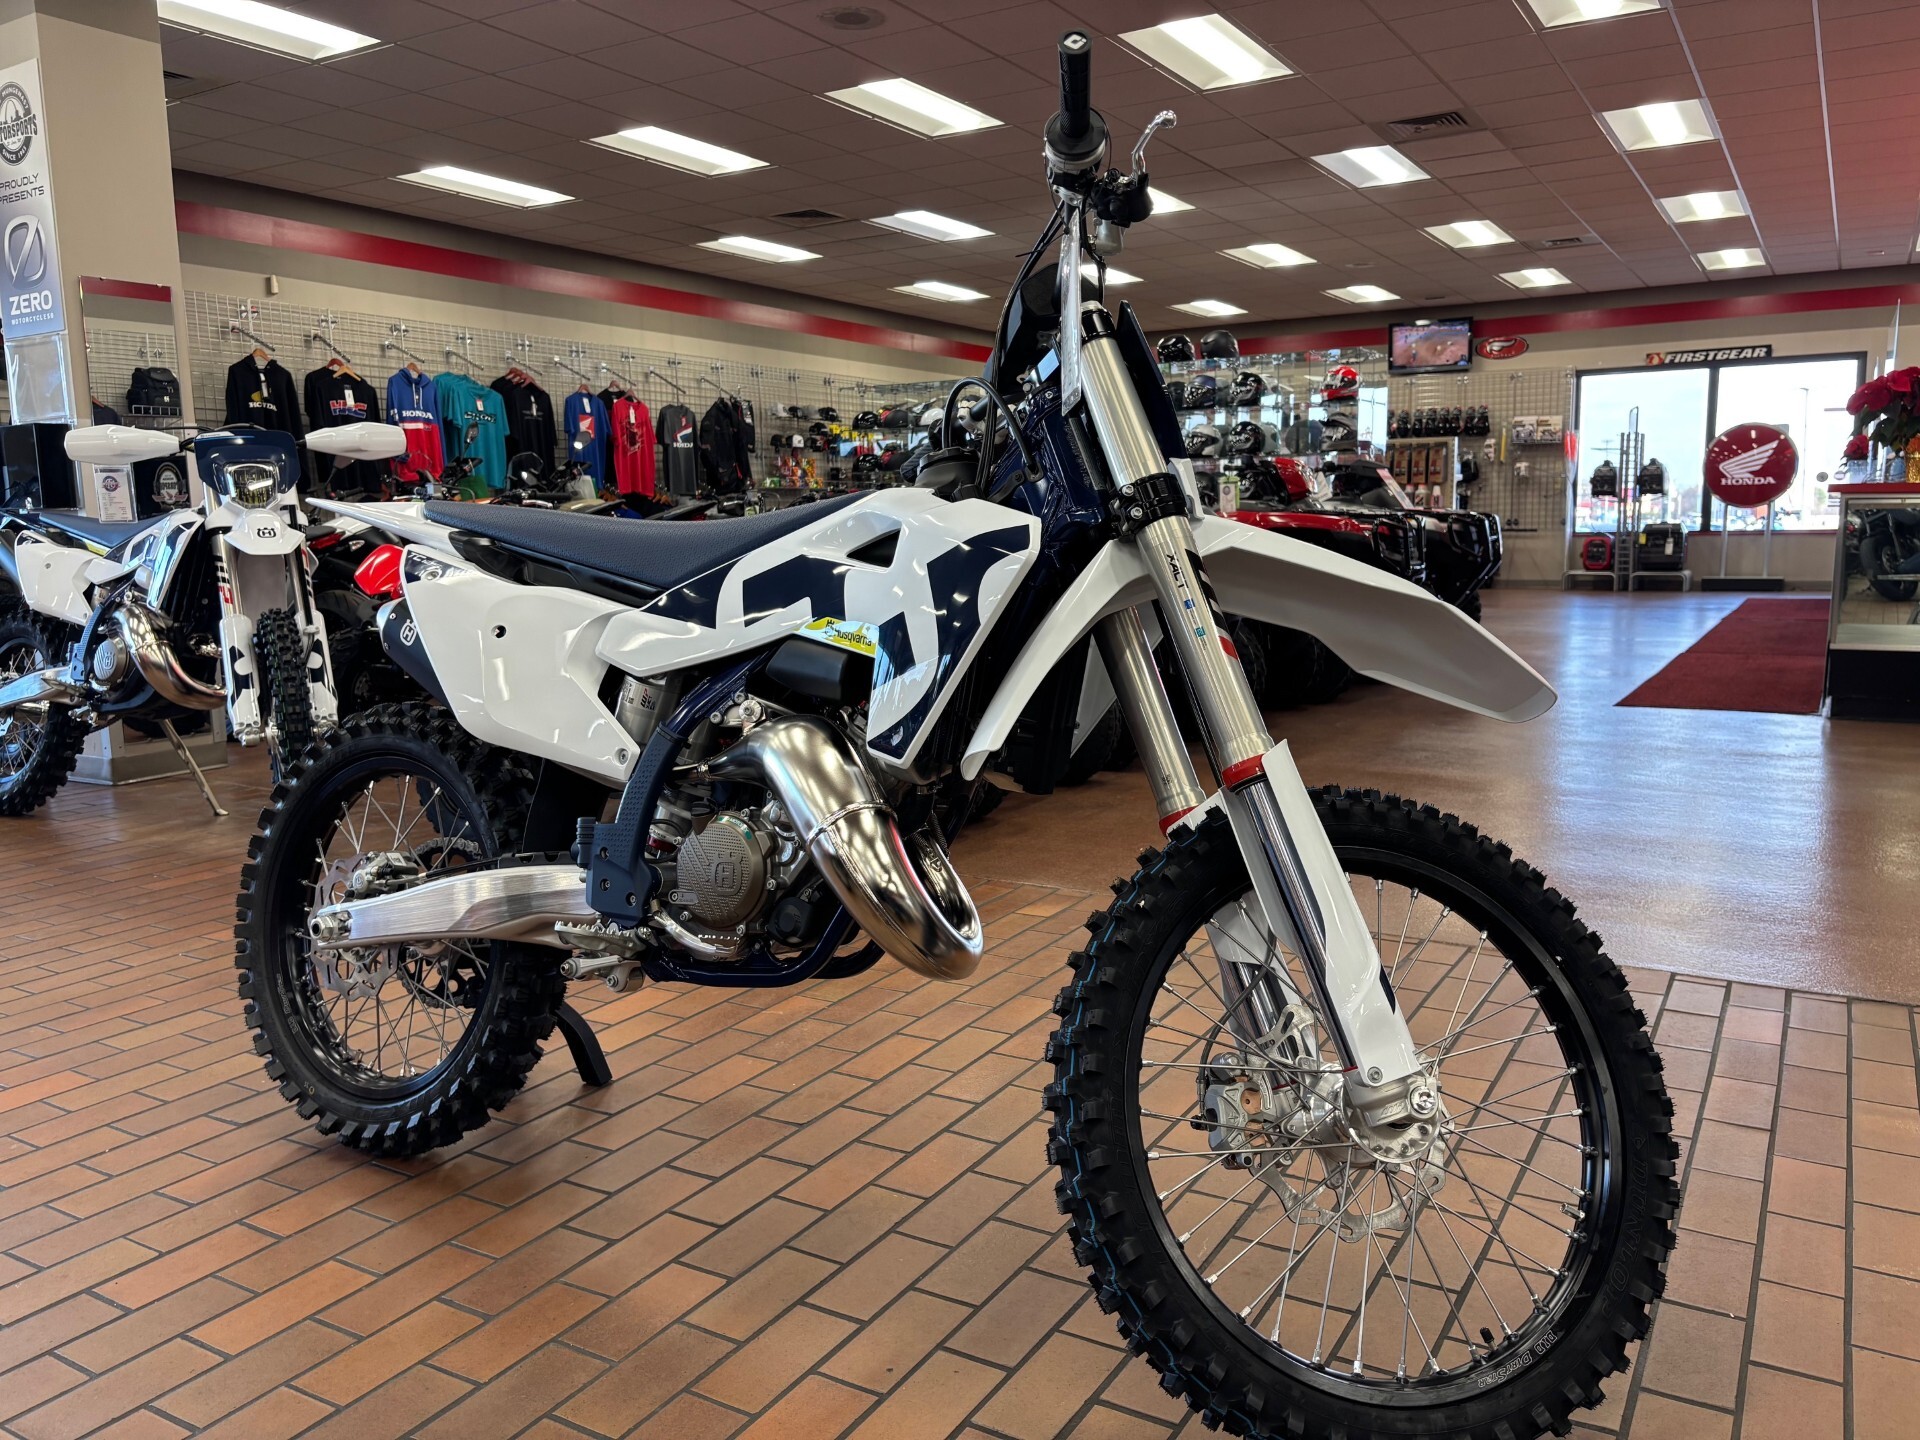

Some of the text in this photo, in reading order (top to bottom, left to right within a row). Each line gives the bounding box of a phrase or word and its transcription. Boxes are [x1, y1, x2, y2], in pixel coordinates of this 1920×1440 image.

[9, 290, 53, 316] ZERO
[11, 312, 54, 325] MOTORCYCLES
[1663, 346, 1768, 364] FIRSTGEAR
[401, 409, 434, 420] HONDA
[1720, 475, 1777, 486] HONDA
[1601, 1159, 1650, 1319] DUNLOP
